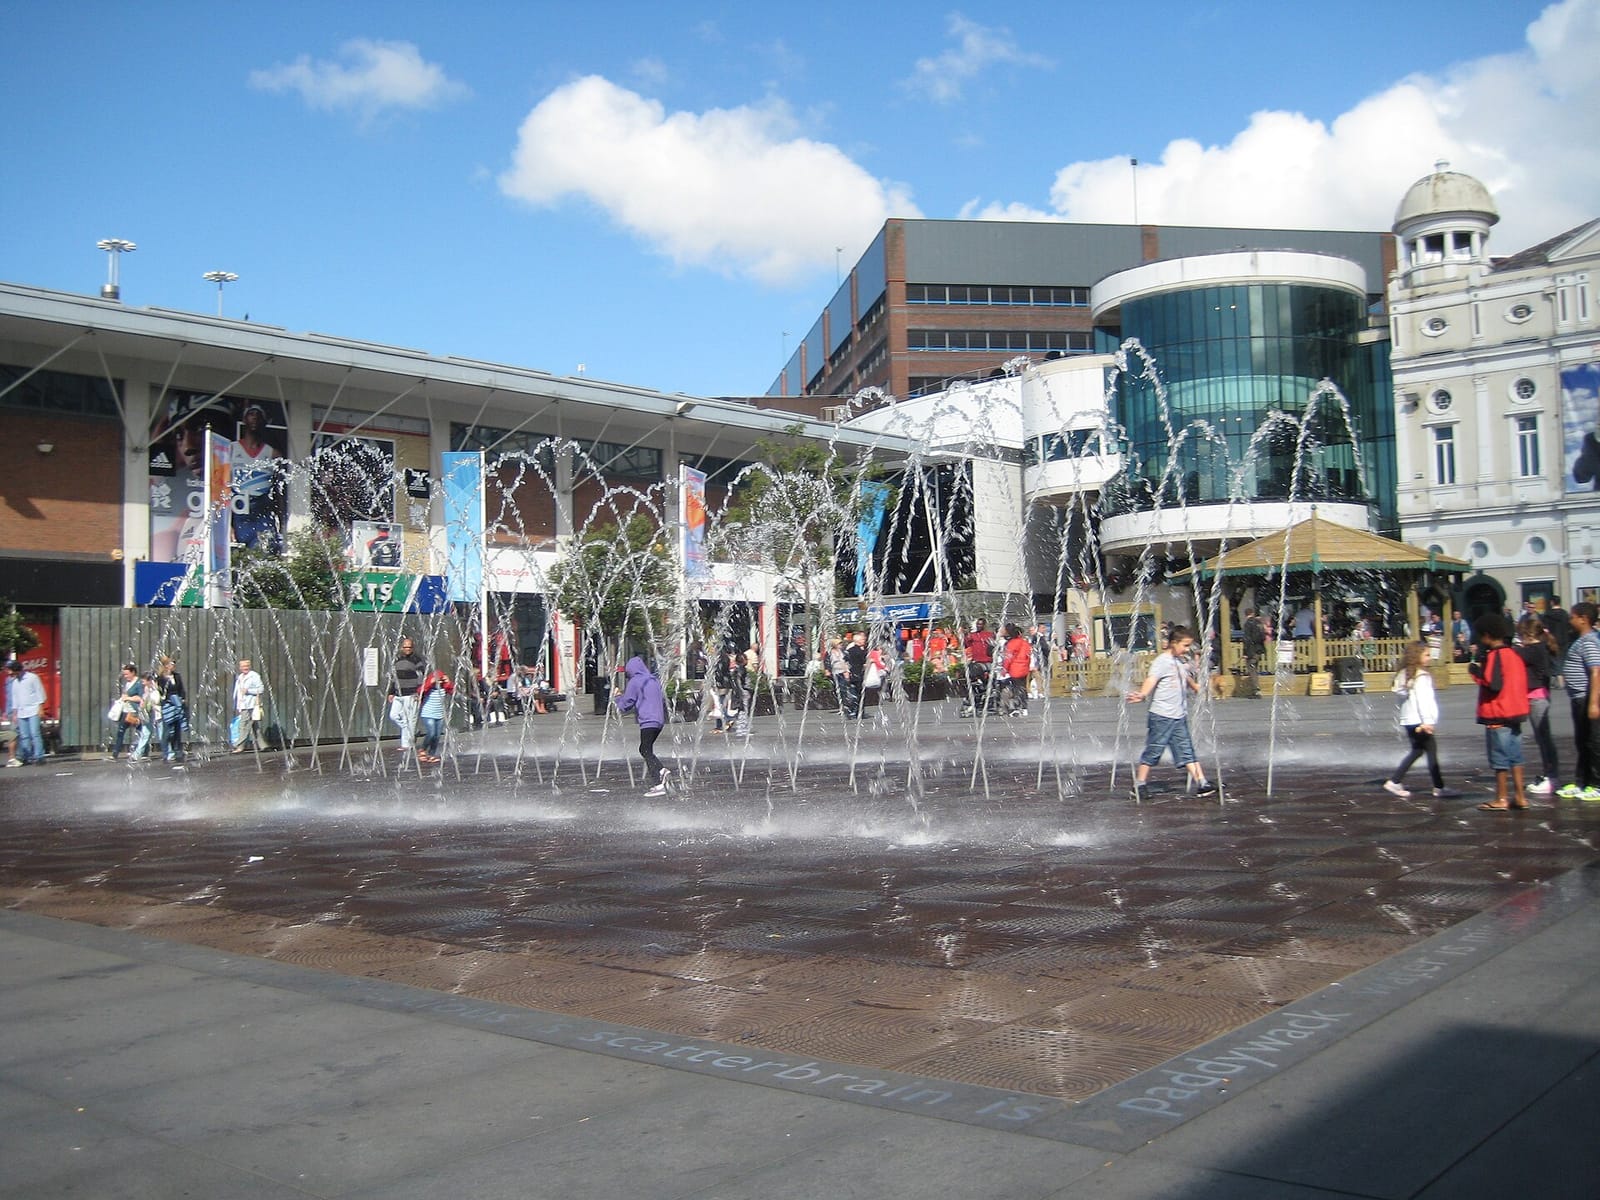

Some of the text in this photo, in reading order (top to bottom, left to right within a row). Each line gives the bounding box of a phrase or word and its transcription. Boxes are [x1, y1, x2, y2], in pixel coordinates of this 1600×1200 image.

[578, 1029, 953, 1105] scatterbrain
[976, 1094, 1044, 1121] is
[1117, 1010, 1353, 1117] paddywack
